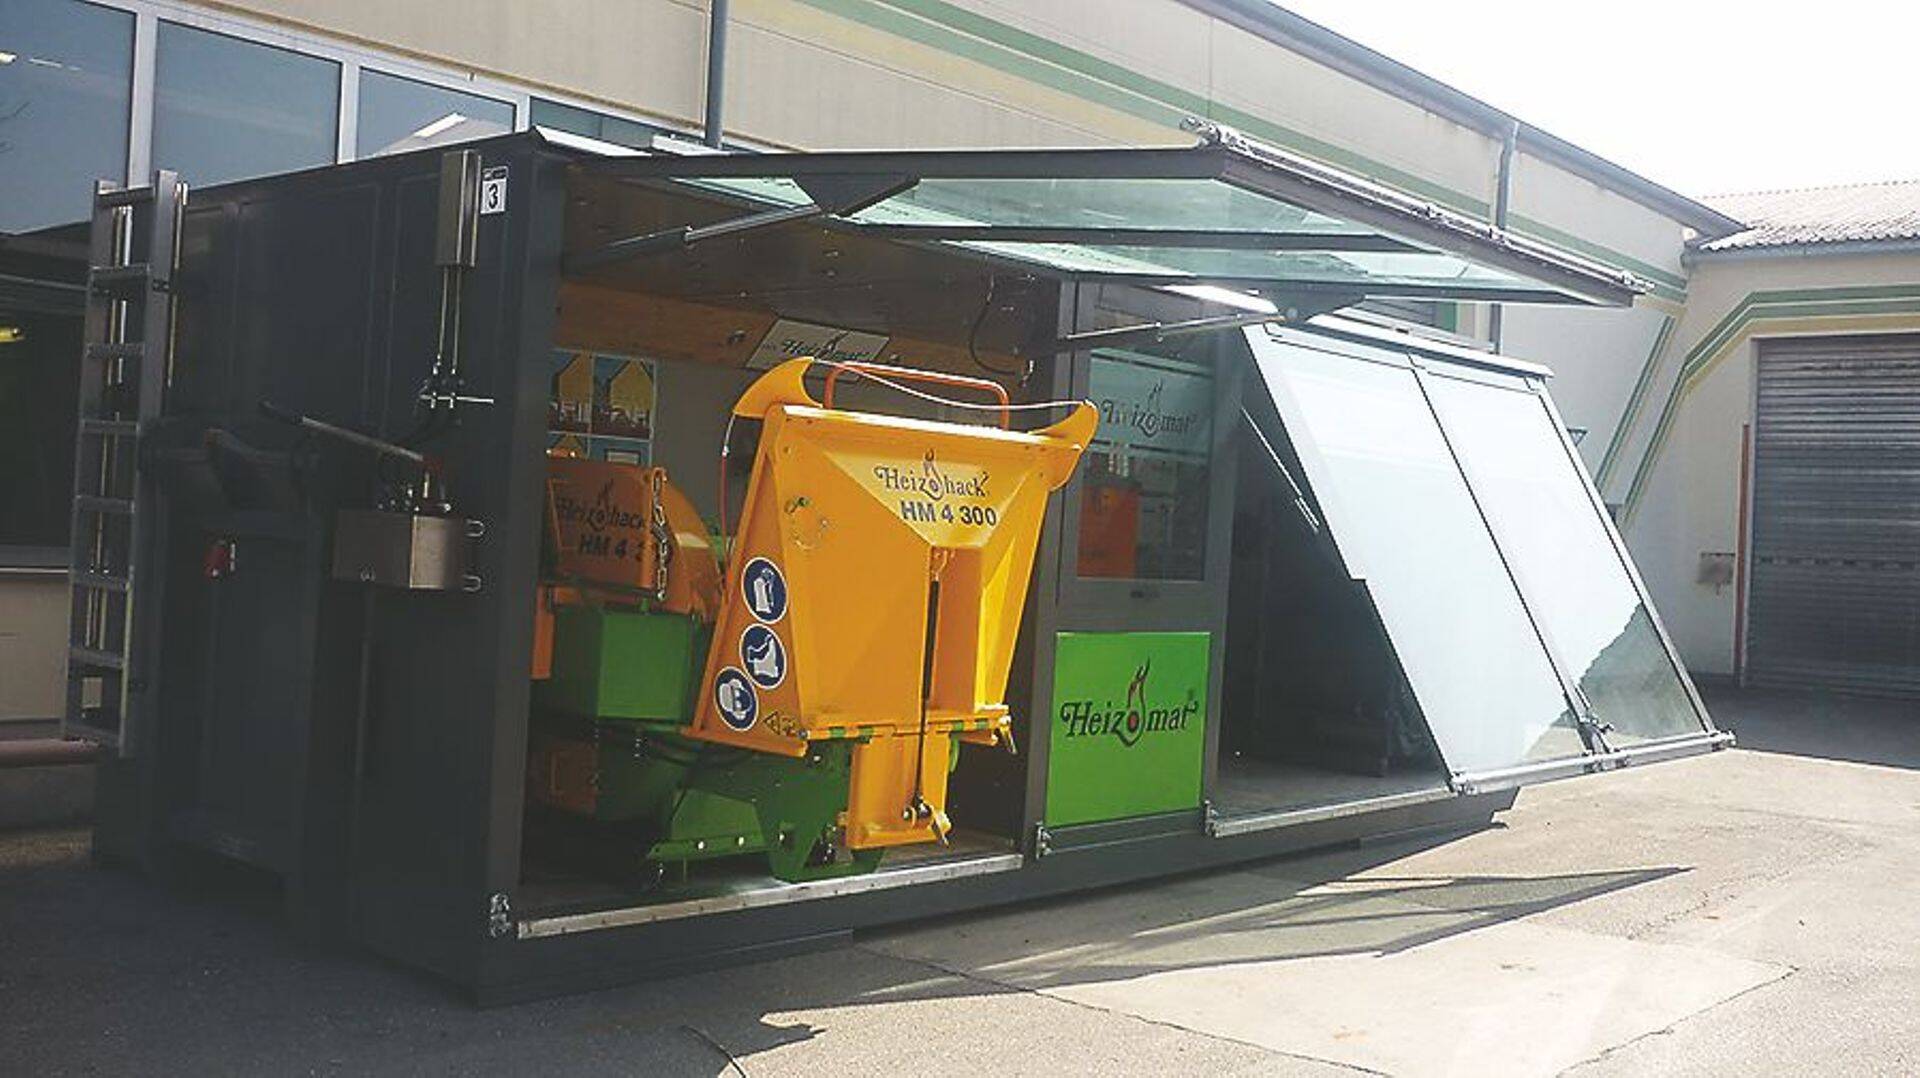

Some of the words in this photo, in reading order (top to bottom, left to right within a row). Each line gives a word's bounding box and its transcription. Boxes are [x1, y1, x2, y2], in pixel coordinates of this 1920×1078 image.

[488, 183, 499, 210] 3
[873, 460, 990, 501] Heizohack
[901, 501, 937, 523] HM
[941, 504, 954, 524] 4
[959, 505, 998, 527] 300
